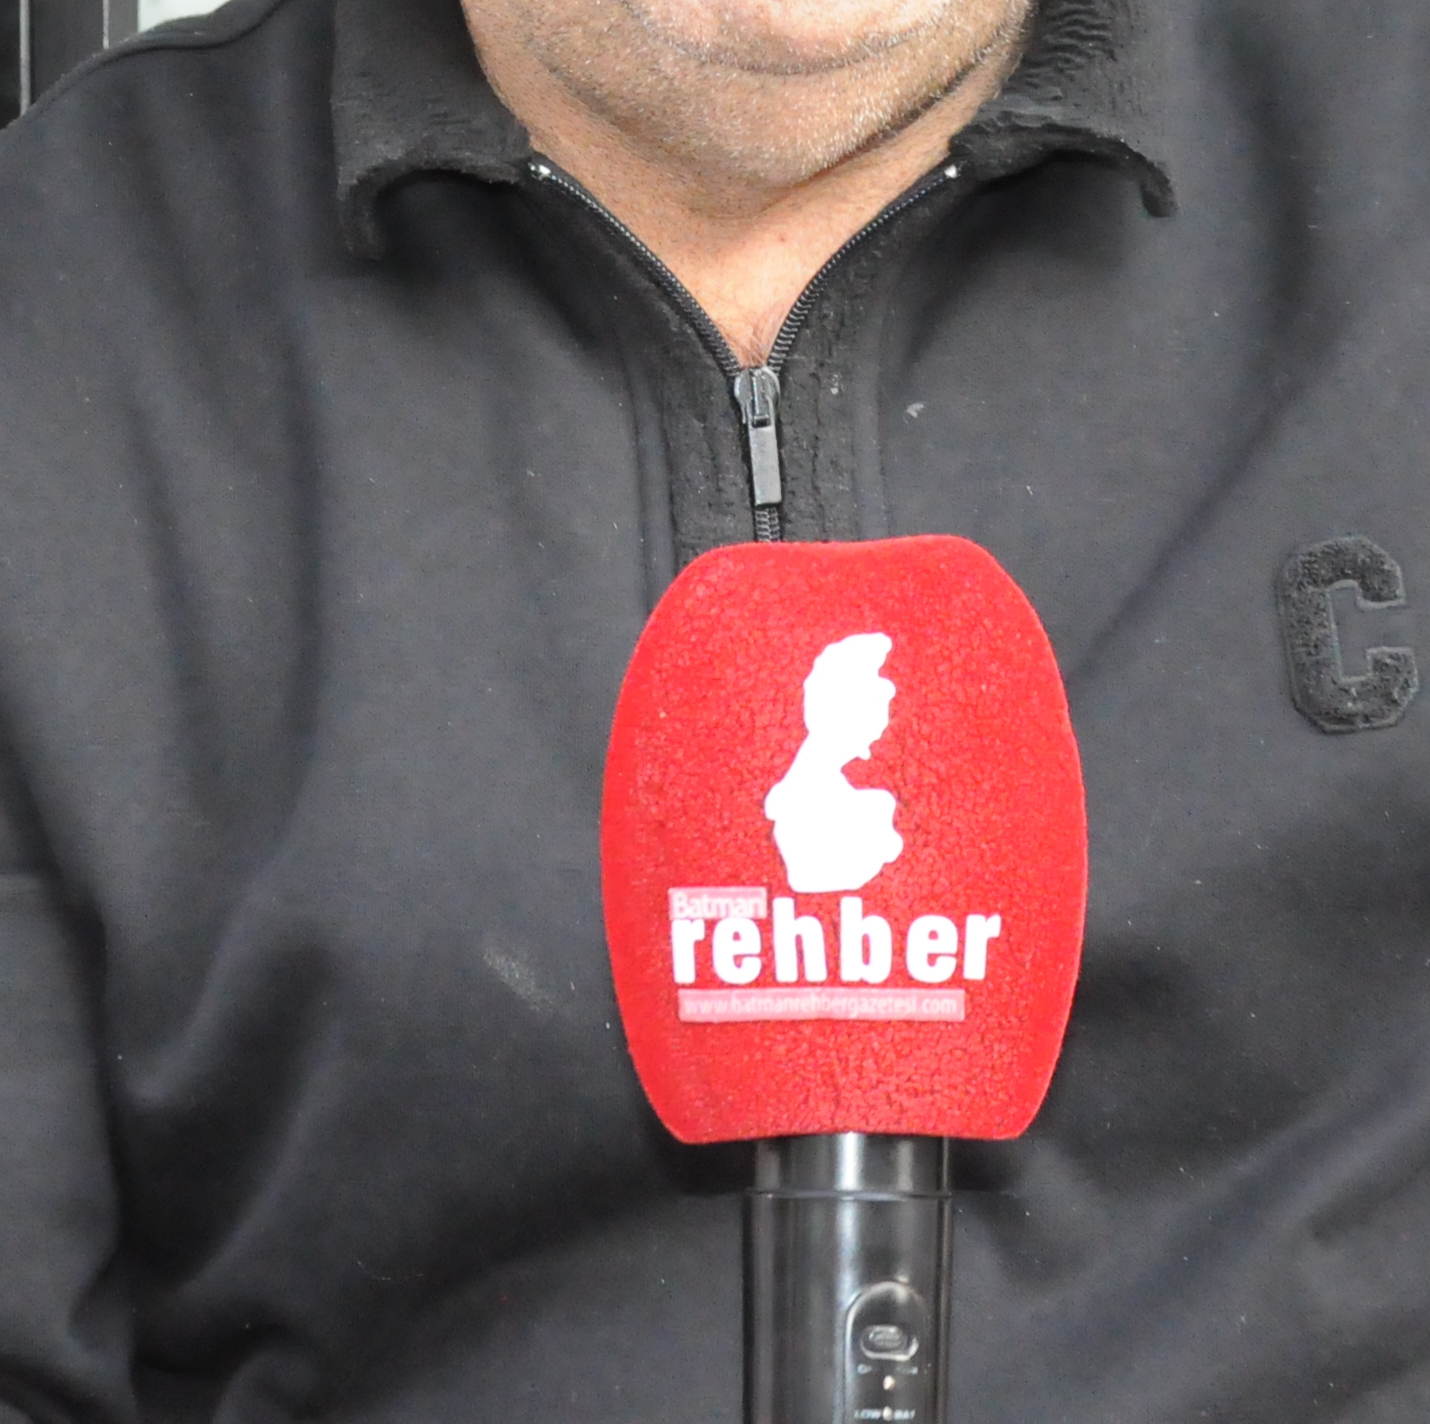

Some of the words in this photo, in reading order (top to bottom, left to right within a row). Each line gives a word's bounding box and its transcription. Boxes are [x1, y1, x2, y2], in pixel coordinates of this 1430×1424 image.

[1279, 534, 1420, 736] C
[671, 895, 1003, 985] rehber
[673, 890, 766, 918] Batman
